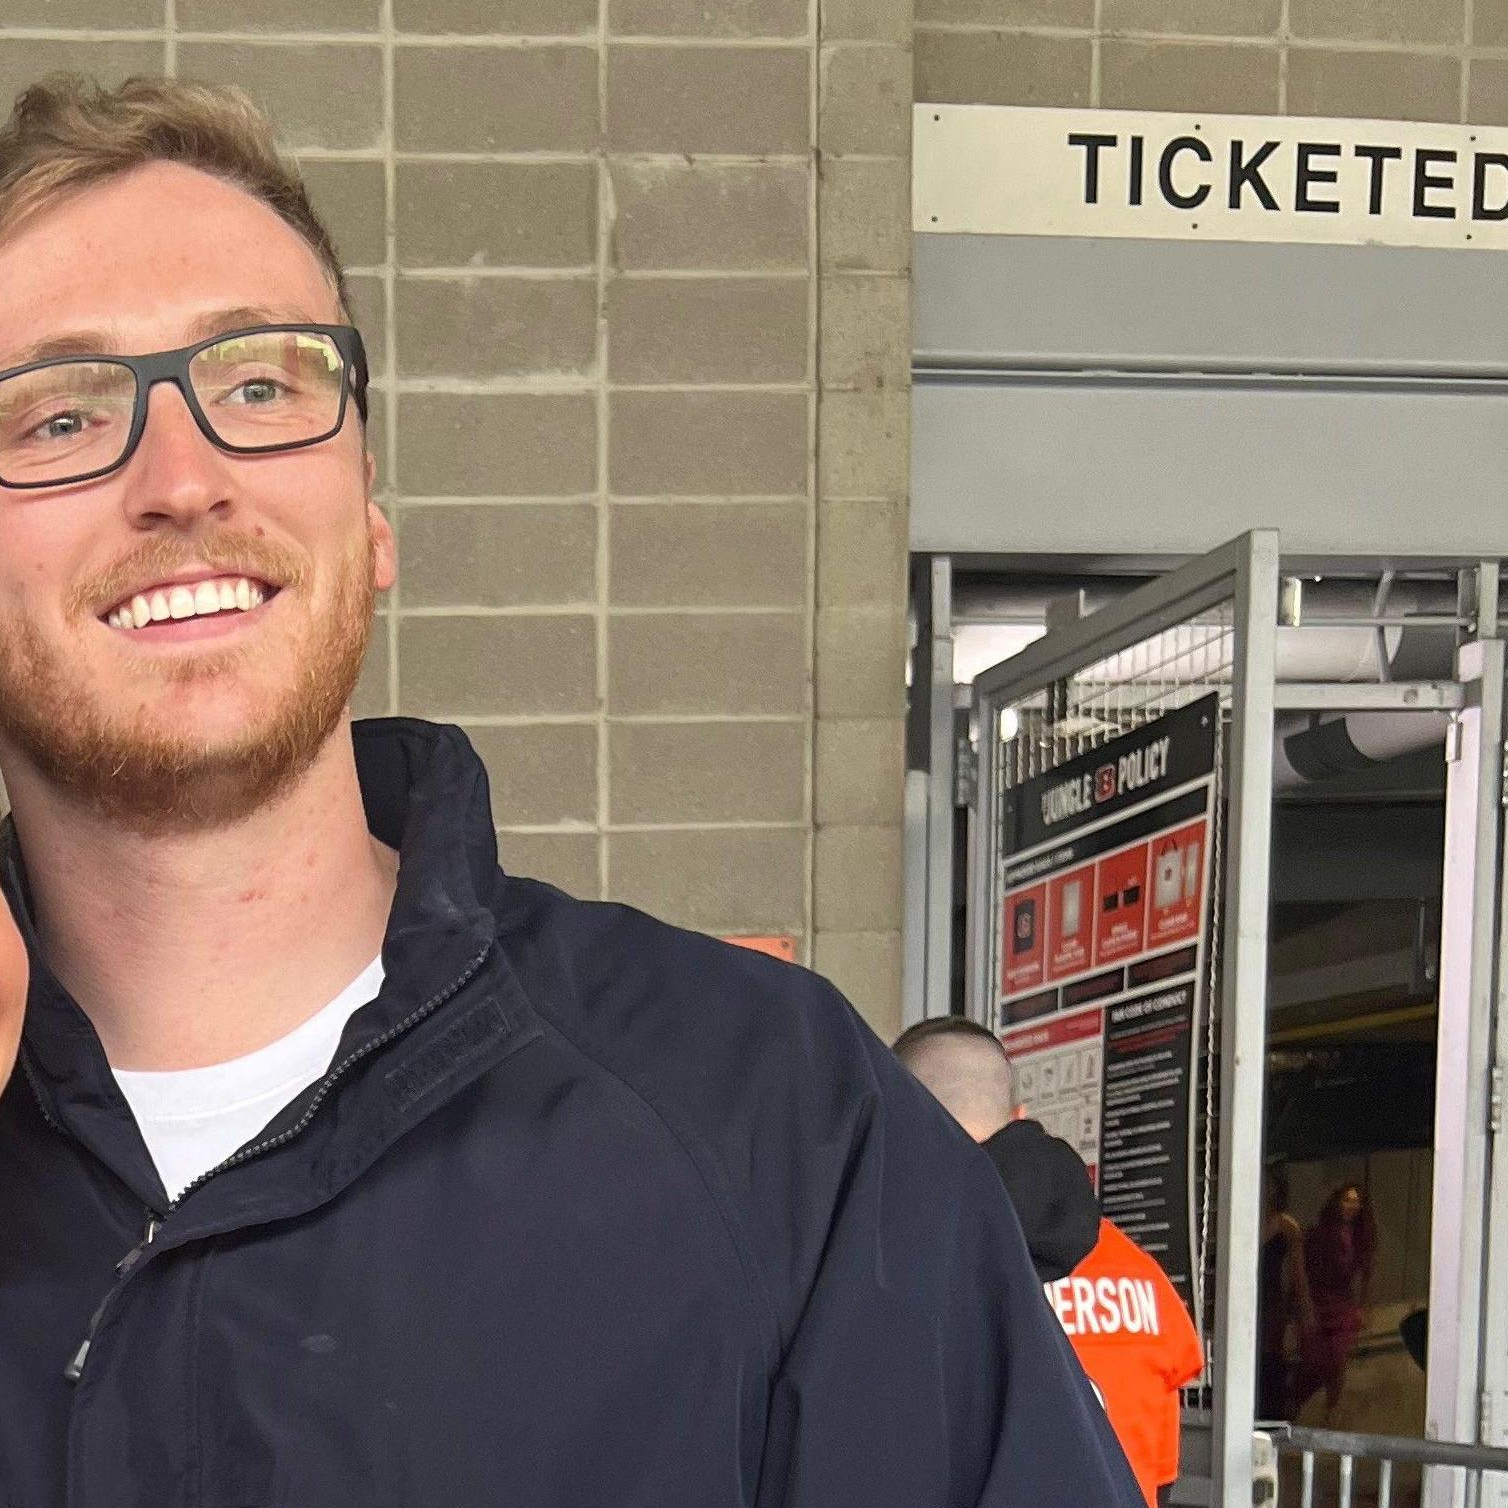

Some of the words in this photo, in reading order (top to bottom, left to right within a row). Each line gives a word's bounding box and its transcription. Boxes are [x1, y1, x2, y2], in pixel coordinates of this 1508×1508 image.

[1067, 132, 1508, 221] TICKETED
[1117, 735, 1171, 796] POLICY
[1043, 1275, 1160, 1336] ERSON
